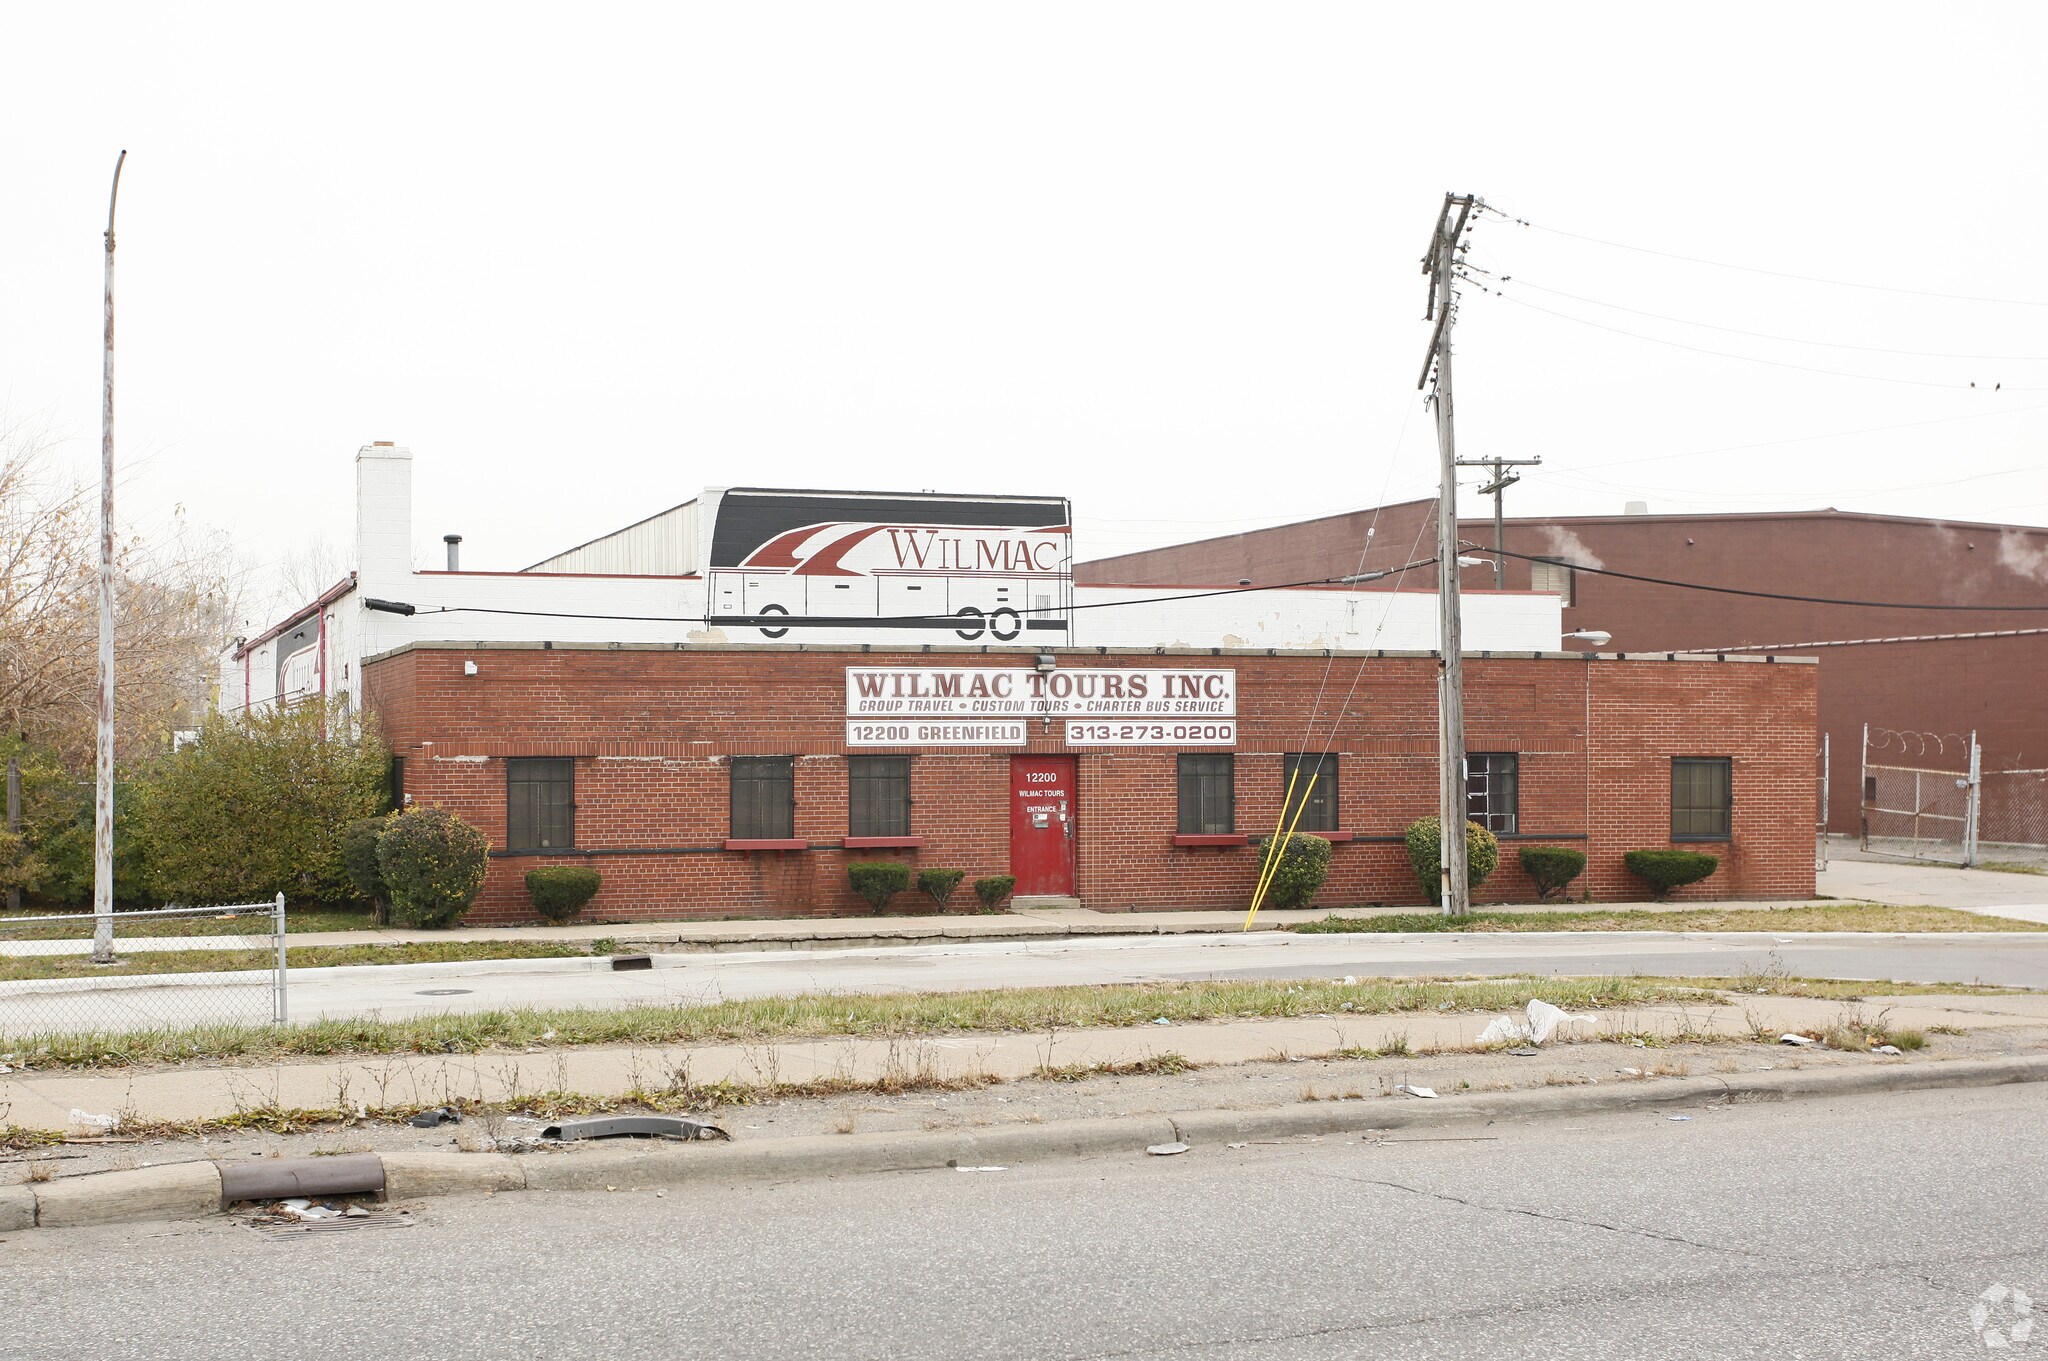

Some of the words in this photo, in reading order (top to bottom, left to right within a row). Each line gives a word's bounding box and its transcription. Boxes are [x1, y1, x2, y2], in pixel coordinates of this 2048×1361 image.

[886, 528, 1058, 571] WILMAC
[852, 673, 1013, 698] WILMAC
[1025, 672, 1149, 699] TOURS
[1162, 674, 1230, 699] INC.
[858, 700, 903, 712] GROUP
[908, 700, 954, 712] TRAVEL
[971, 700, 1025, 712] CUSTOM
[1030, 700, 1069, 712] TOURS
[1086, 700, 1141, 712] CHARTER
[1146, 700, 1171, 712] BUS
[1174, 700, 1224, 712] SERVICE
[853, 726, 910, 741] 12200
[917, 726, 1021, 741] GREENFIELD
[1070, 725, 1232, 740] 313-273-0200
[1026, 773, 1056, 782] 12200
